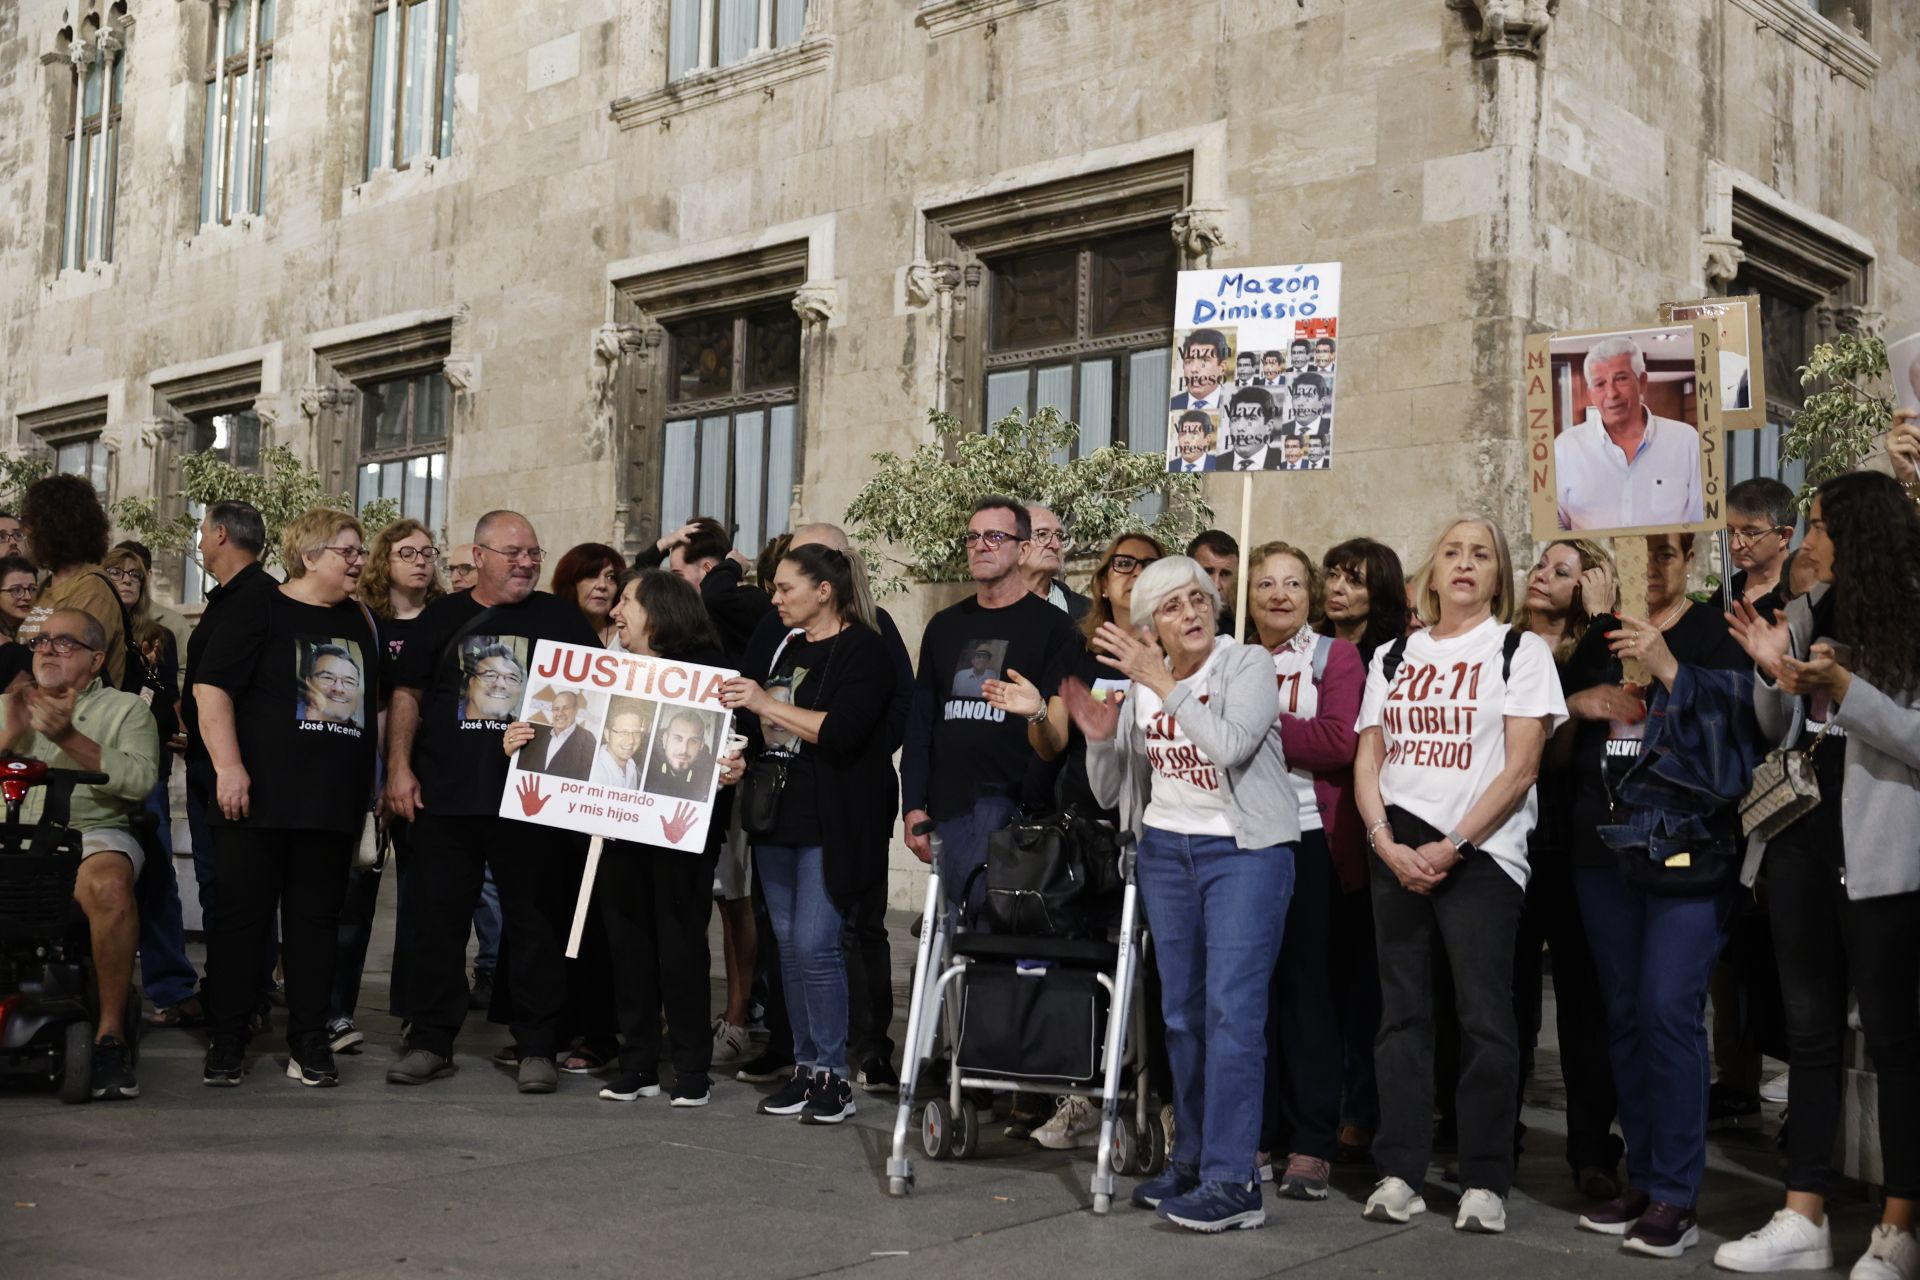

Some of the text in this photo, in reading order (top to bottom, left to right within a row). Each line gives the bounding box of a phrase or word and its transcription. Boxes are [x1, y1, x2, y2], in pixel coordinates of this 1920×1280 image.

[1217, 265, 1319, 298] Mazón
[1192, 293, 1319, 324] Dimissió
[1179, 375, 1227, 391] preso
[1527, 351, 1549, 493] MAZÓN
[1225, 433, 1274, 450] preso
[538, 648, 726, 703] JUSTICIA
[1386, 661, 1484, 702] 20:11
[299, 720, 361, 738] José Vicente
[460, 719, 510, 731] José Vice
[1408, 706, 1477, 735] OBLIT
[1166, 744, 1216, 770] OBL
[1400, 737, 1472, 771] PERDÓ
[561, 782, 655, 807] por mi marido
[568, 802, 640, 822] y mis hijos
